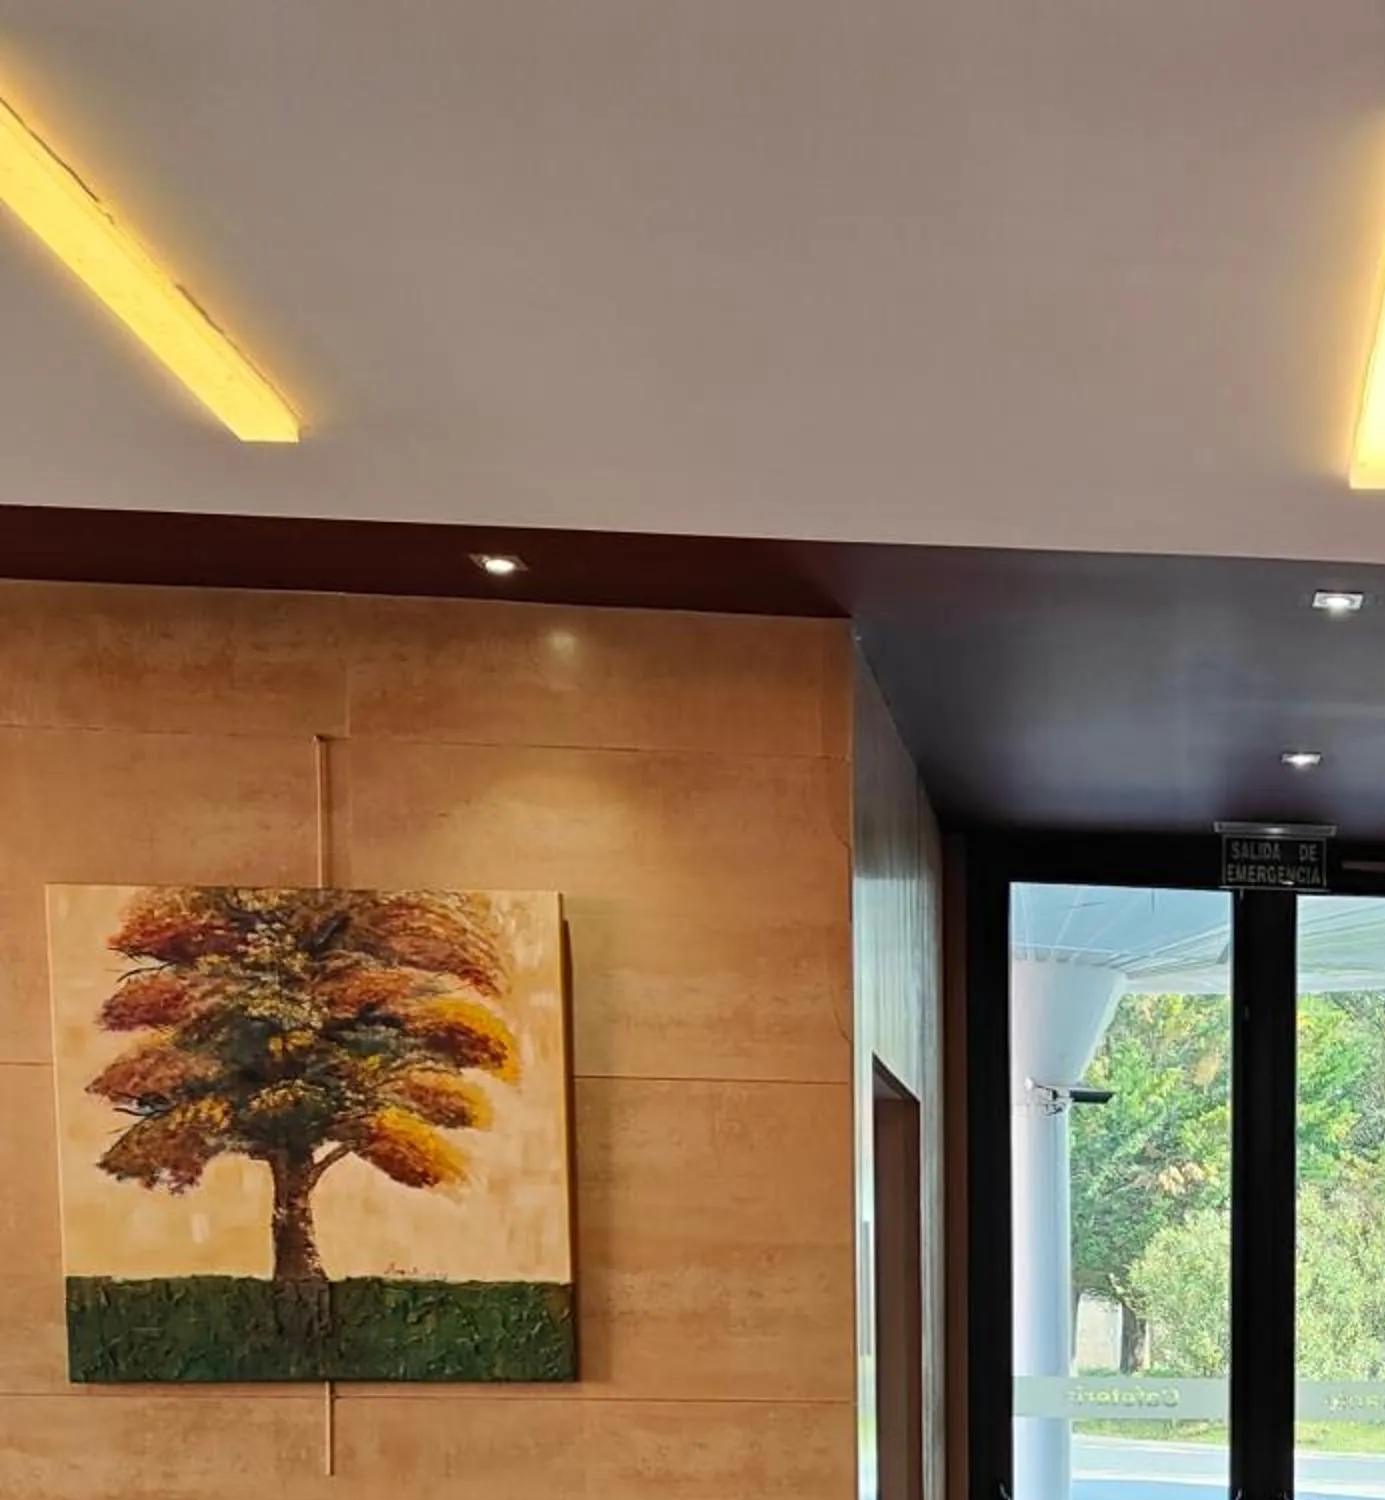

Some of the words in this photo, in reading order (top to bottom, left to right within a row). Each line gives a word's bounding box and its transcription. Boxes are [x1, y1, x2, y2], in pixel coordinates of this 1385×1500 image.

[1231, 840, 1281, 860] SALIDA
[1299, 843, 1320, 862] DE
[1226, 863, 1321, 884] EMERGENCIA
